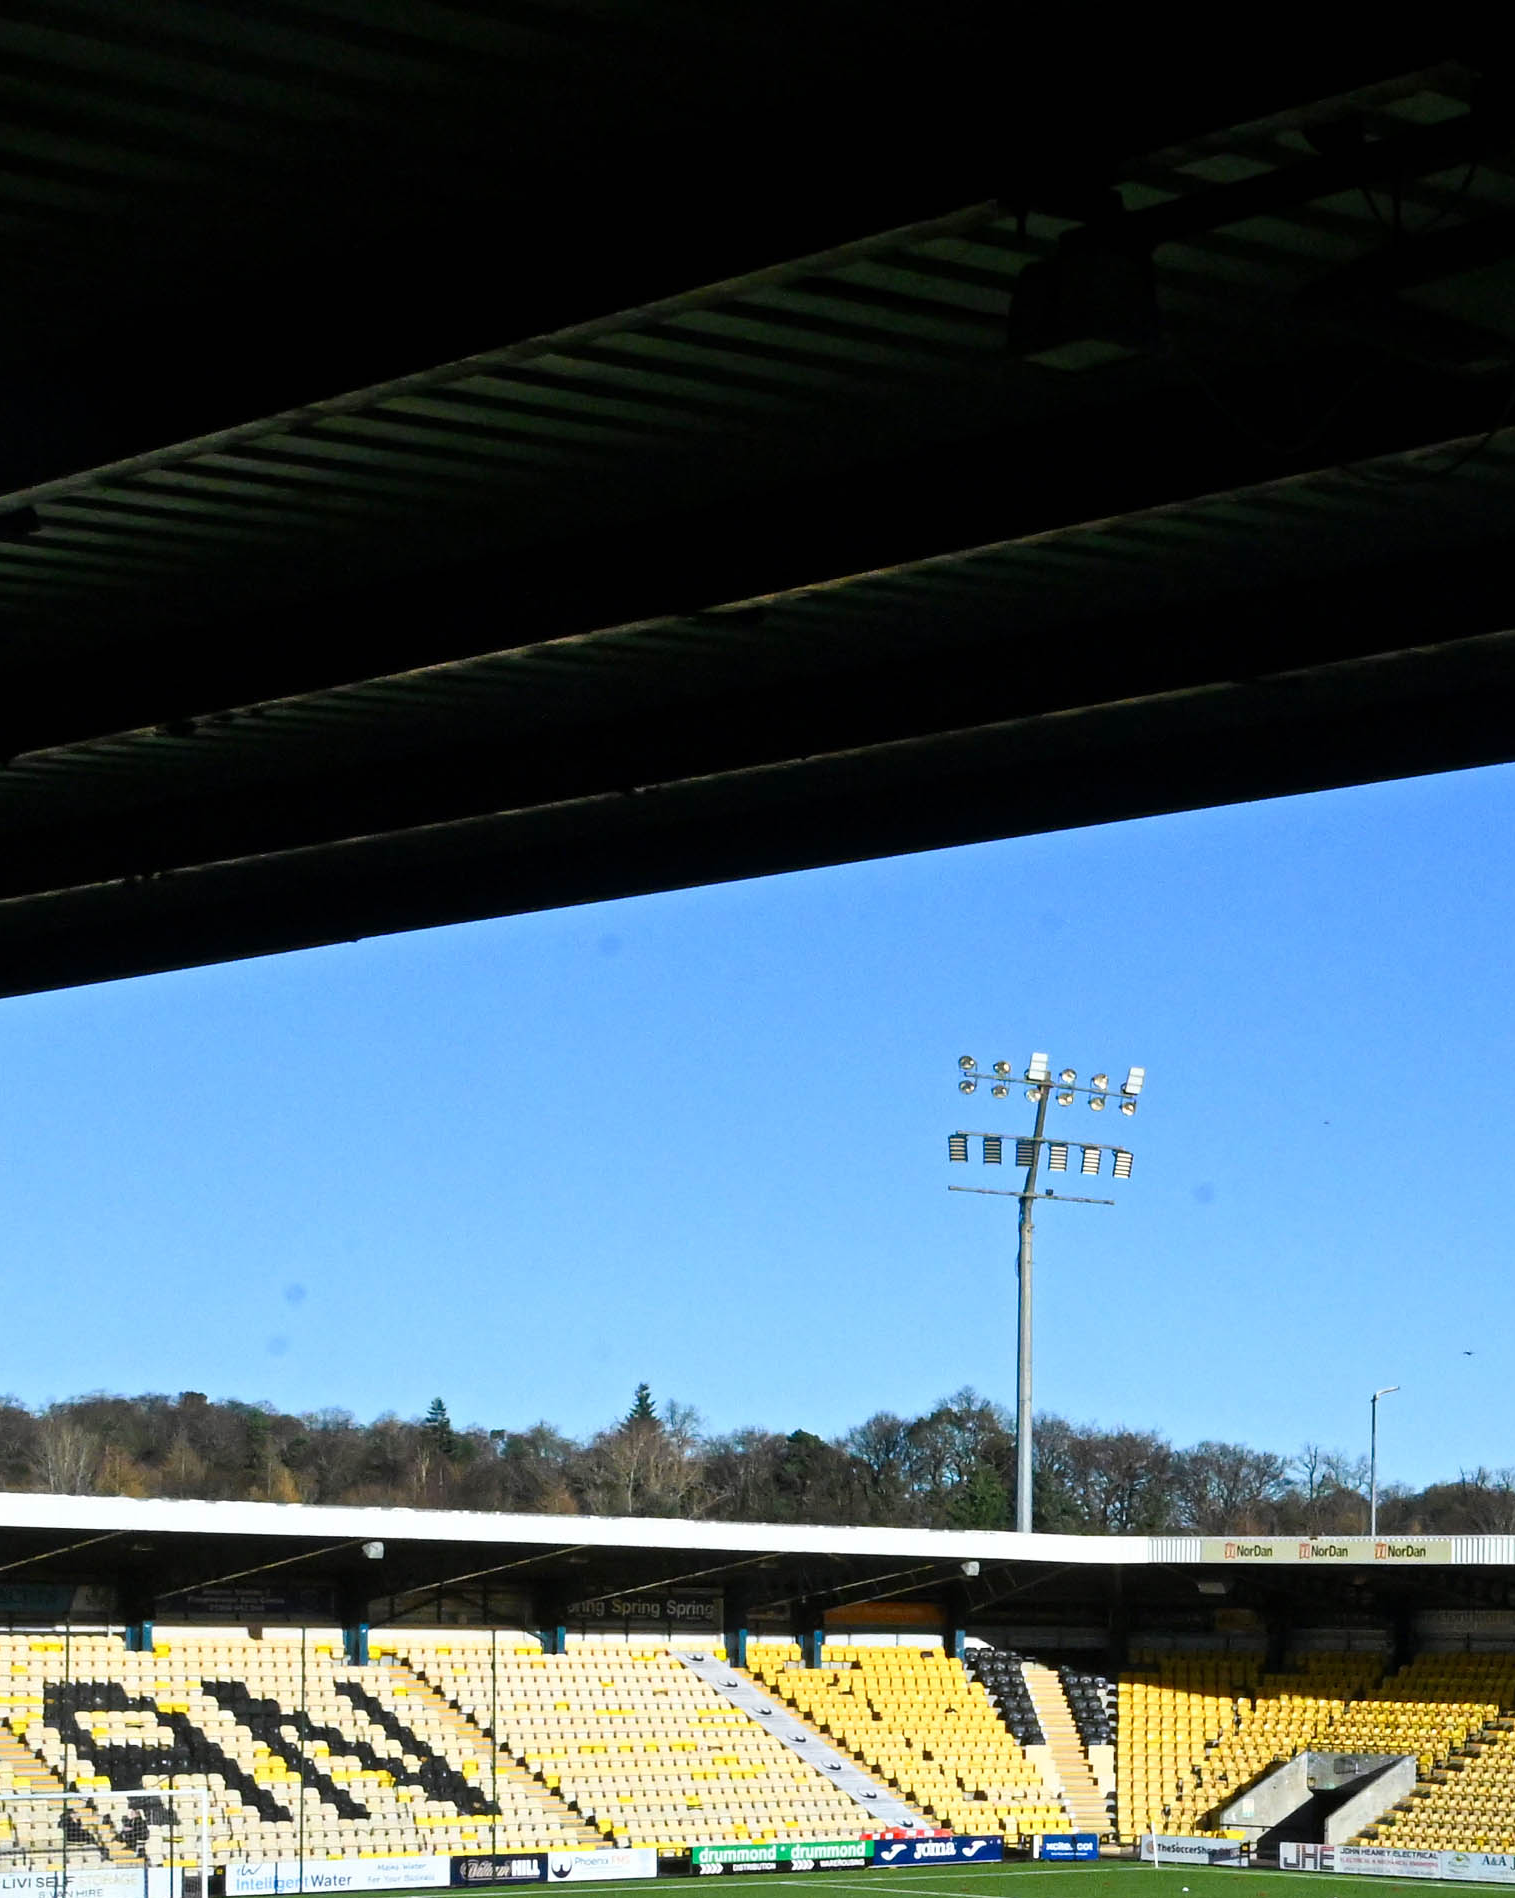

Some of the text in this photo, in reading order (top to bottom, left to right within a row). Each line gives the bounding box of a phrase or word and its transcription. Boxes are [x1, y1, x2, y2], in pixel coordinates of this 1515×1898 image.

[1236, 1544, 1274, 1557] NorDan
[1311, 1544, 1349, 1557] NorDan
[1387, 1544, 1427, 1558] NorDan
[611, 1600, 661, 1618] Spring
[666, 1600, 714, 1618] Spring
[698, 1842, 866, 1862] drummond drummond
[1283, 1844, 1335, 1870] JHE
[511, 1858, 541, 1877] HILL
[1481, 1856, 1507, 1868] A&A
[2, 1877, 34, 1889] LIVI
[35, 1875, 75, 1888] SELF
[76, 1888, 104, 1898] HIRE
